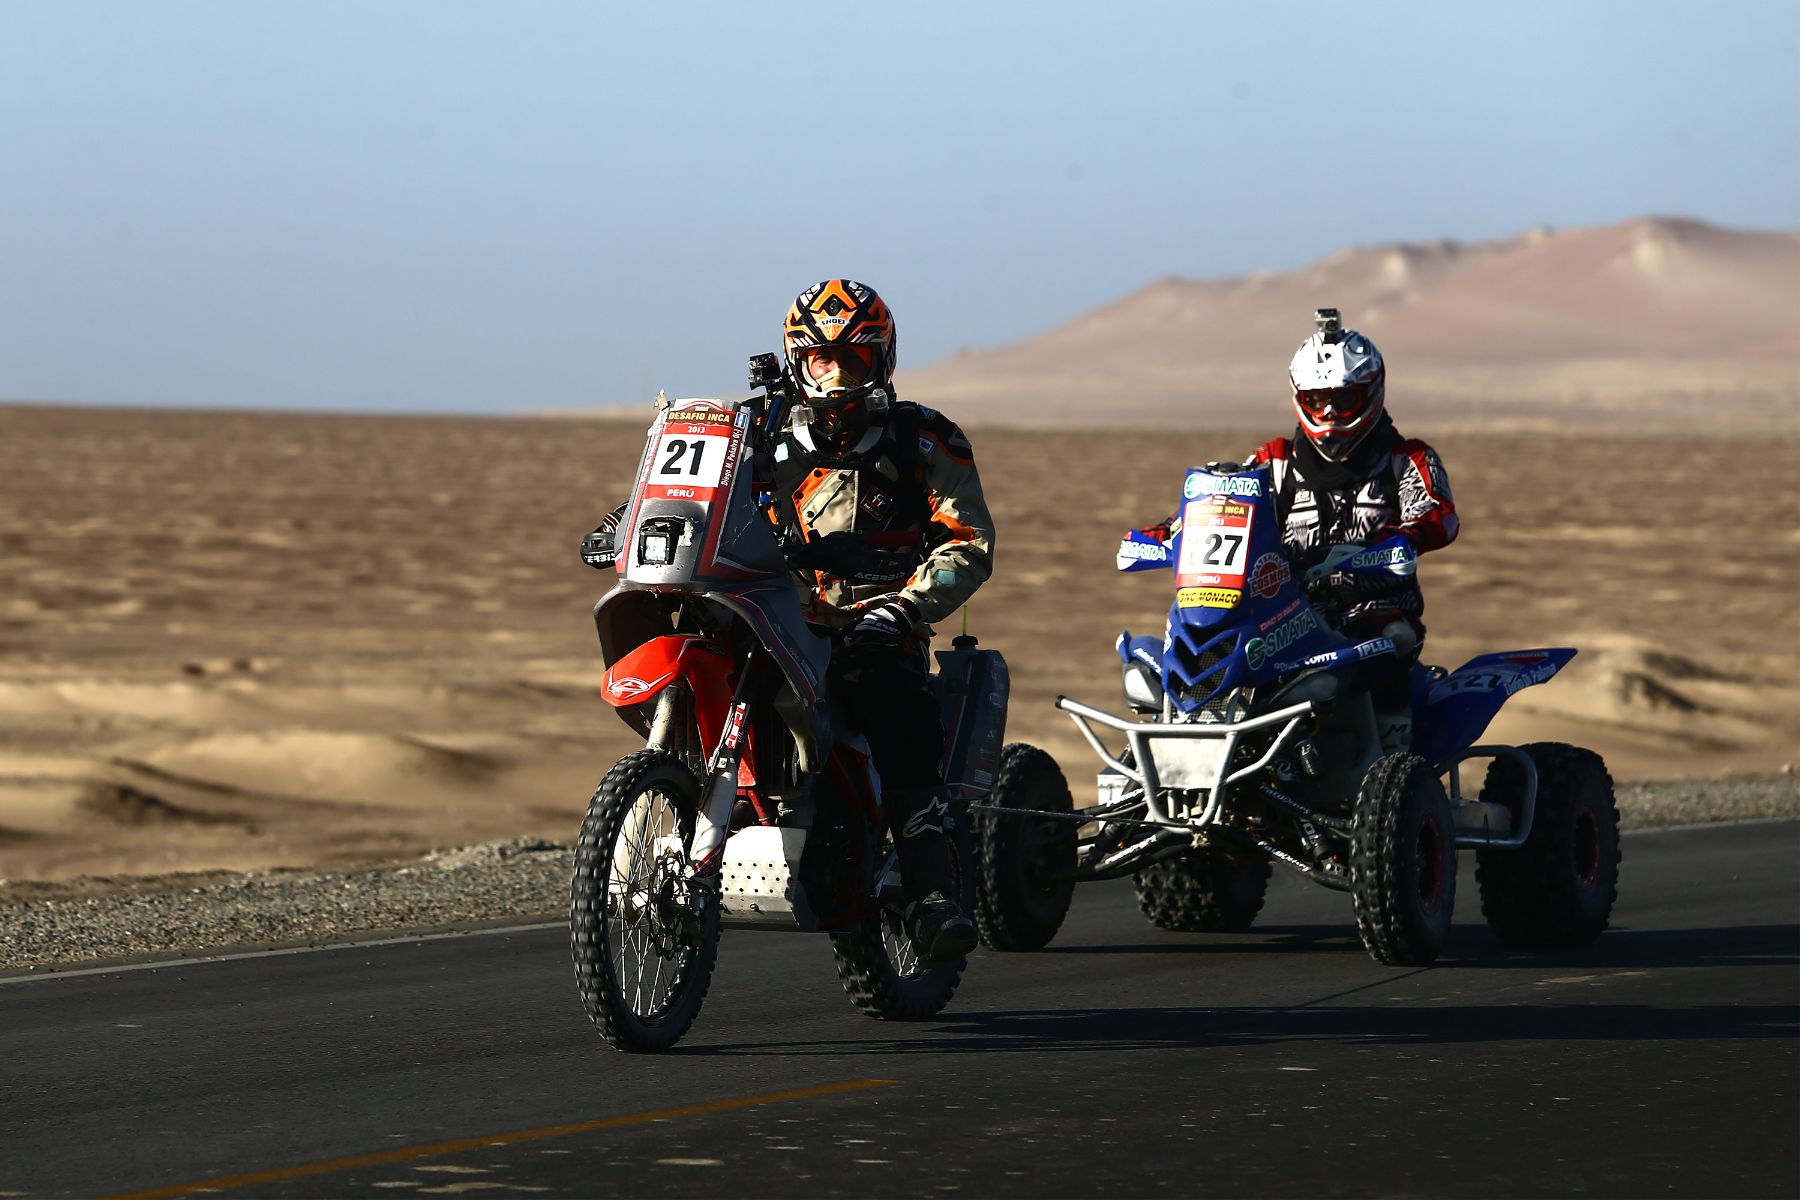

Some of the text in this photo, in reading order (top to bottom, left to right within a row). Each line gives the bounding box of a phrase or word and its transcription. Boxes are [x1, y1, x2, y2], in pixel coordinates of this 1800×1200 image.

[821, 318, 846, 326] SHOEI
[668, 412, 731, 423] DESAFIO INCA
[660, 439, 706, 476] 21
[666, 488, 695, 498] PERÚ
[1188, 533, 1243, 566] 27
[1353, 547, 1408, 568] SMATA
[1251, 566, 1289, 593] COSMOS
[1199, 592, 1240, 605] MONACO
[1265, 607, 1318, 658] SMATA
